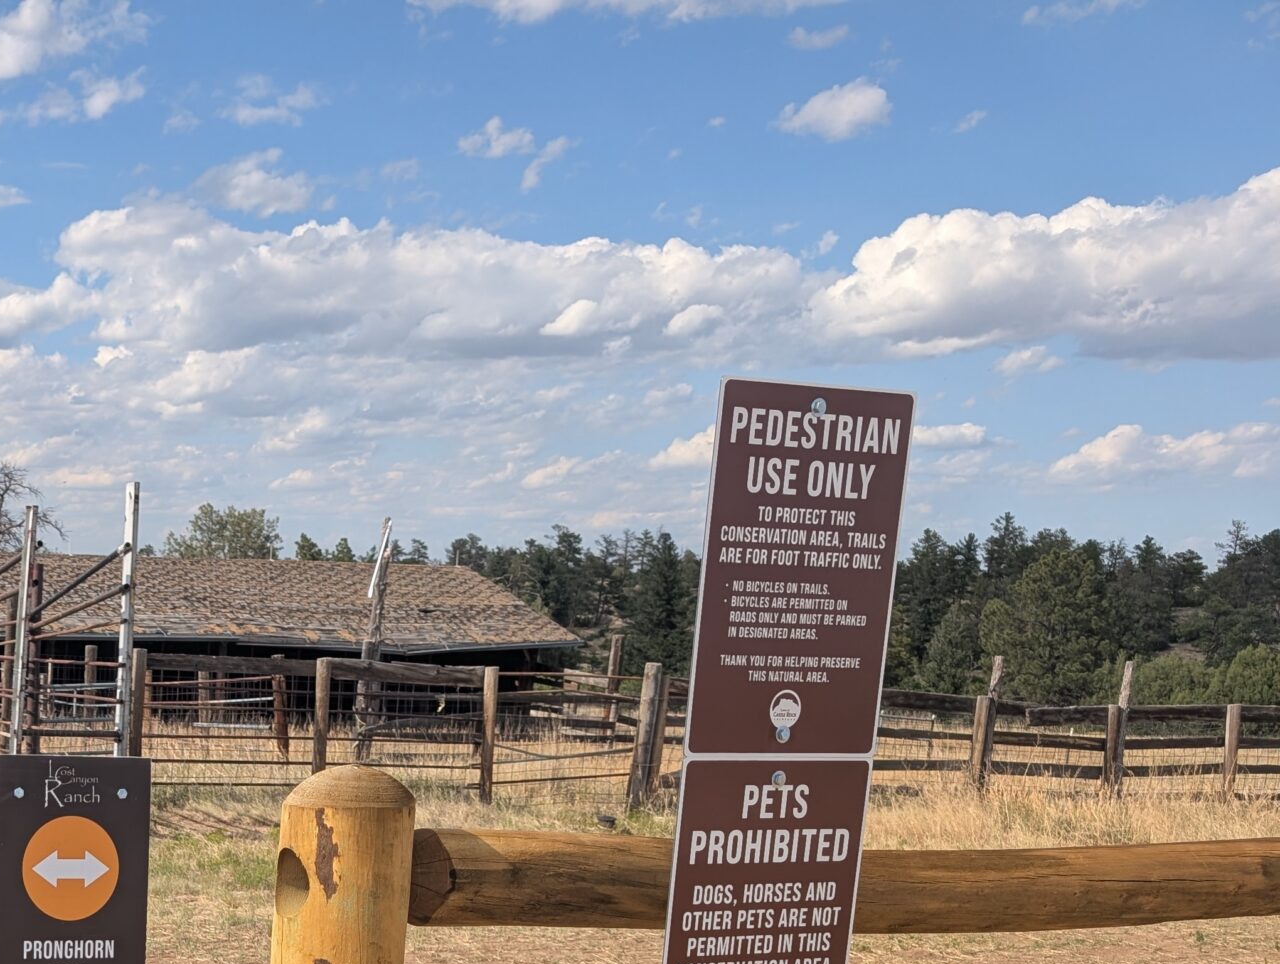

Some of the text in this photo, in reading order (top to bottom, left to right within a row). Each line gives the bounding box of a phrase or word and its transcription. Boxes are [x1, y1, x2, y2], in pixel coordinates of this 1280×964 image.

[730, 407, 900, 454] PEDESTRIAN
[747, 457, 875, 499] USE ONLY
[759, 507, 856, 526] TO PROTECT THIS
[721, 526, 886, 549] CONSERVATION AREA, TRAILS
[720, 548, 882, 570] ARE FOR FOOT TRAFFIC ONLY.
[733, 581, 830, 595] NO BICYCLES ON TRAILS.
[731, 596, 848, 610] BICYCLES ARE PERMITTED ON
[730, 611, 866, 626] ROADS ONLY AND MUST BE PARKED
[728, 627, 818, 640] IN DESIGNATED AREAS.
[720, 655, 860, 668] THANK YOU FOR HELPING PRESERVE
[749, 670, 829, 683] THIS NATURAL AREA.
[50, 760, 75, 780] Lost
[55, 766, 98, 786] Canyon
[45, 778, 100, 808] Ranch
[742, 785, 809, 819] PETS
[689, 828, 849, 864] PROHIBITED
[693, 882, 836, 906] DOGS, HORSES AND
[682, 907, 841, 932] OTHER PETS ARE NOT
[23, 939, 114, 960] PRONGHORN
[687, 933, 831, 957] PERMITTED IN THIS
